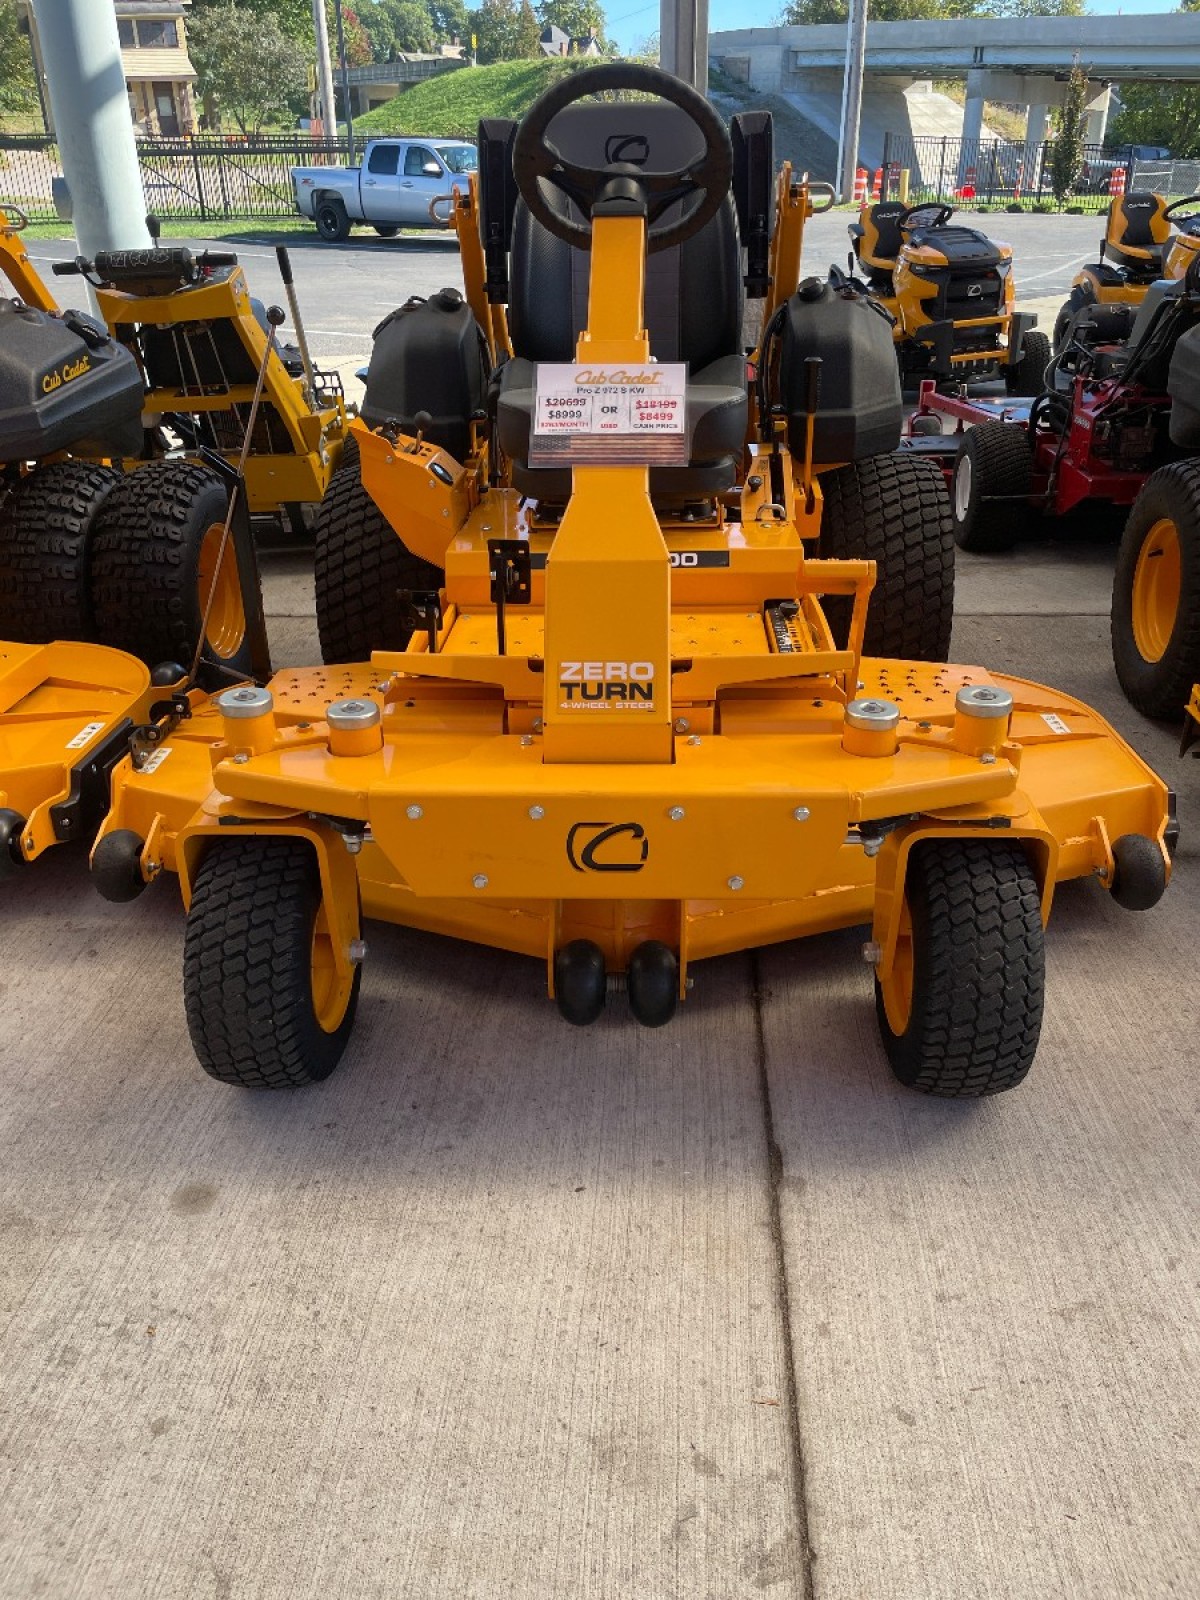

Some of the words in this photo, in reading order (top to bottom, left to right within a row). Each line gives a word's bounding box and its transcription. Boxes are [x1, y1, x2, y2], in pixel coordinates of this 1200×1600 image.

[43, 370, 62, 393] Cub
[63, 356, 91, 381] Cadet
[575, 370, 606, 385] Cub
[608, 370, 663, 385] Cadet
[548, 410, 582, 419] $8999
[601, 406, 618, 414] OR
[560, 662, 654, 681] ZERO
[560, 682, 653, 701] TURN
